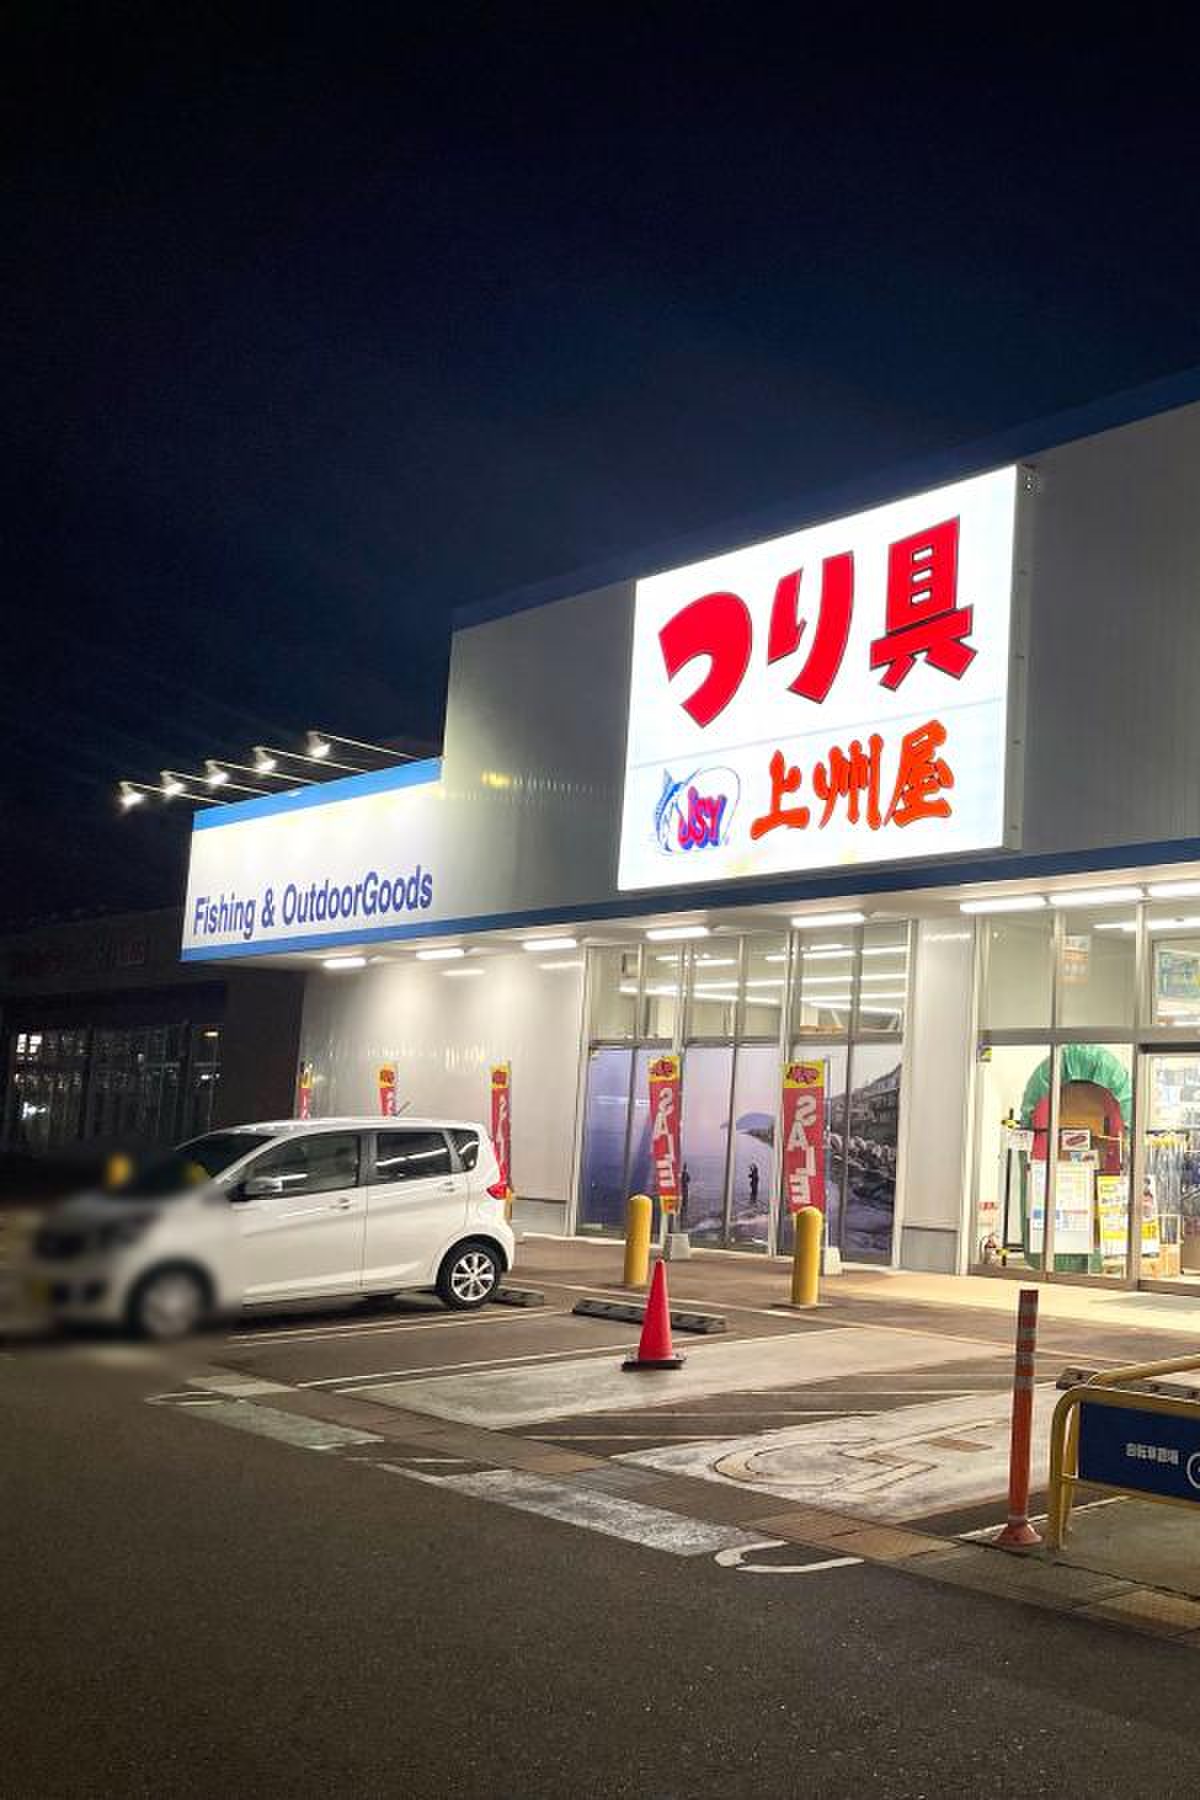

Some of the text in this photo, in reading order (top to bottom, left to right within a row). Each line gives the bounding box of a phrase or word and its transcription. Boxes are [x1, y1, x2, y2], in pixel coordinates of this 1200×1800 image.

[658, 515, 977, 729] つり具
[678, 786, 727, 850] JSY
[750, 719, 955, 841] 上州屋
[193, 893, 256, 940] Fishing
[261, 888, 275, 928] &
